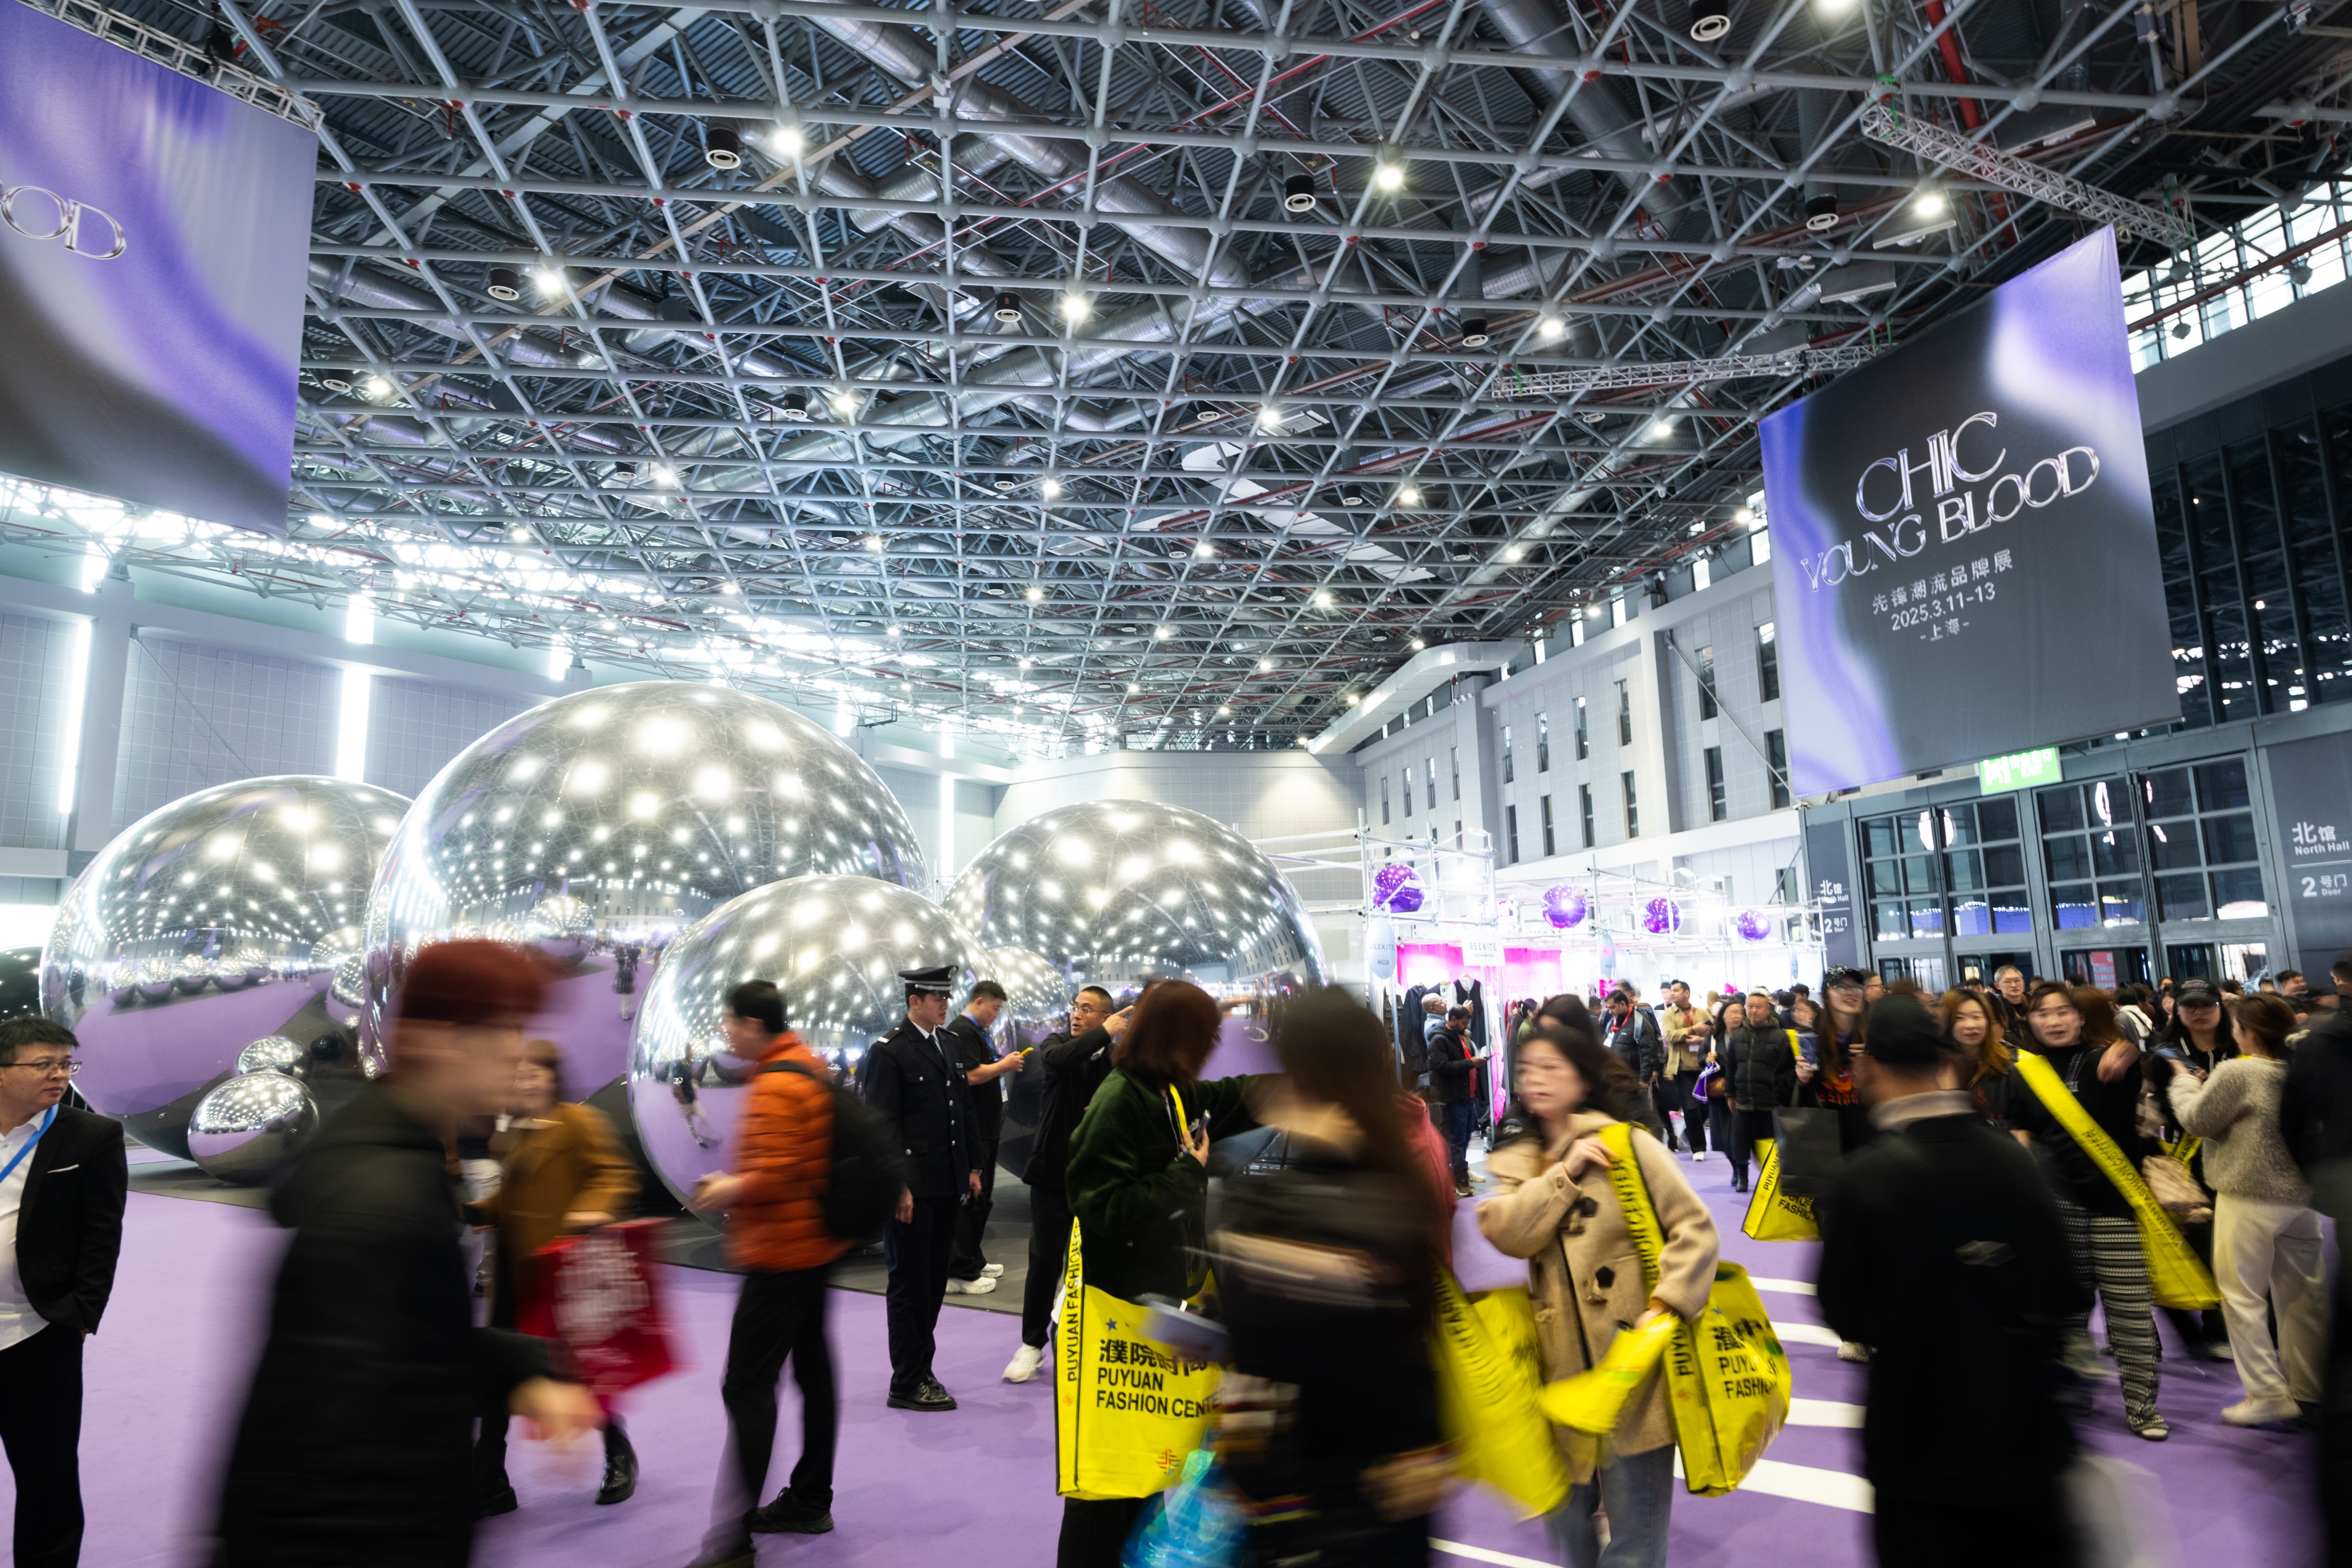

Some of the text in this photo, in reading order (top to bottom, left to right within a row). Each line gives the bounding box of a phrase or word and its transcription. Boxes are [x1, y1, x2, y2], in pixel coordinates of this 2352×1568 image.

[0, 181, 126, 260] OD
[1856, 411, 2006, 522] CHIC
[1800, 446, 2100, 592] YOUNG BLOOD
[1872, 549, 2013, 615] 先锋潮流品牌展
[1891, 582, 1995, 631] 2025.3.11-13
[2292, 822, 2336, 844] 北馆
[2294, 840, 2350, 856] North Hall
[1820, 879, 1843, 896] 北馆
[2301, 873, 2347, 898] 2 号门
[1824, 917, 1848, 934] 2 号门
[1067, 1313, 1079, 1382] PUYUAN
[1097, 1367, 1163, 1391] PUYUAN
[1096, 1390, 1168, 1415] FASHION
